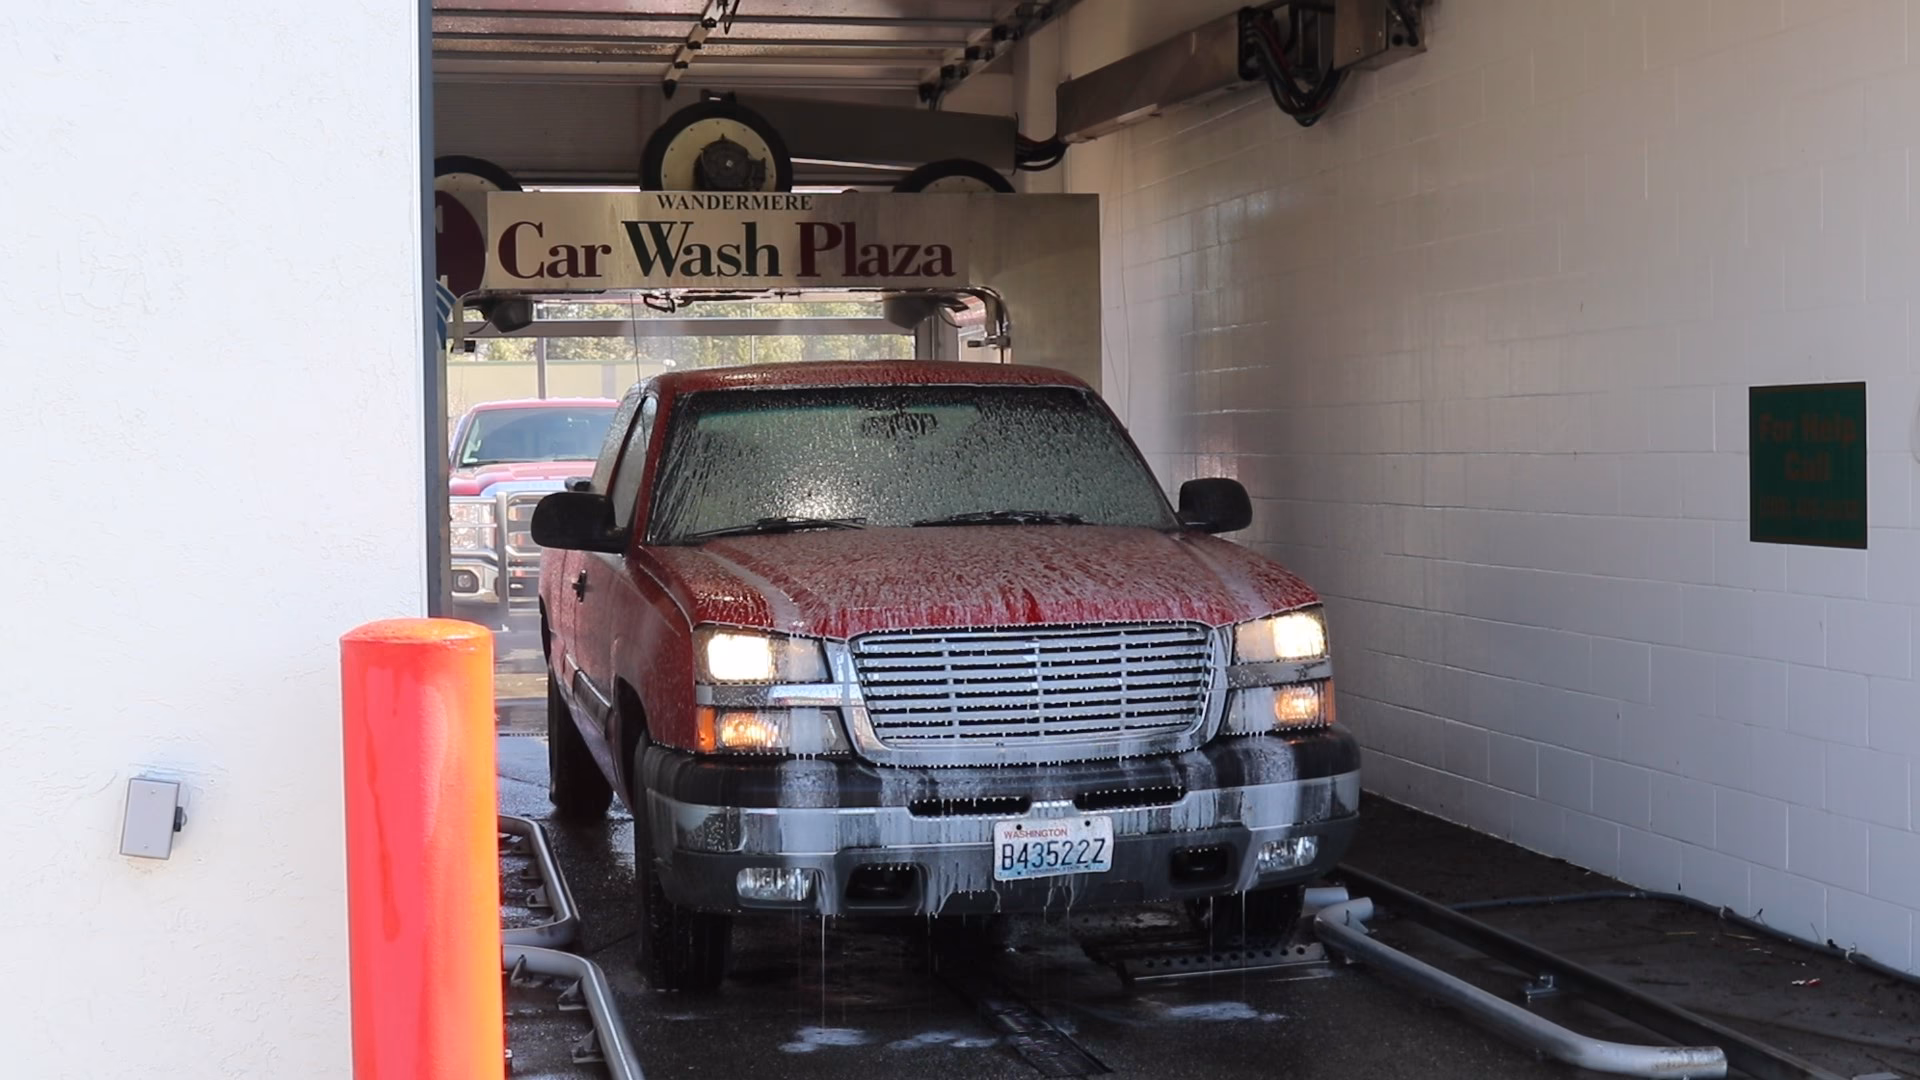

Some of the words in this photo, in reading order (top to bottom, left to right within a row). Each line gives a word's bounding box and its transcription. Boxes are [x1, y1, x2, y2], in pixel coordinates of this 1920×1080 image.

[656, 194, 813, 211] WANDERMERE
[498, 221, 612, 279] Car
[621, 221, 783, 278] Wash
[795, 221, 957, 278] Plaza
[1003, 827, 1068, 840] WASHINGTON
[1001, 838, 1106, 871] B43522Z
